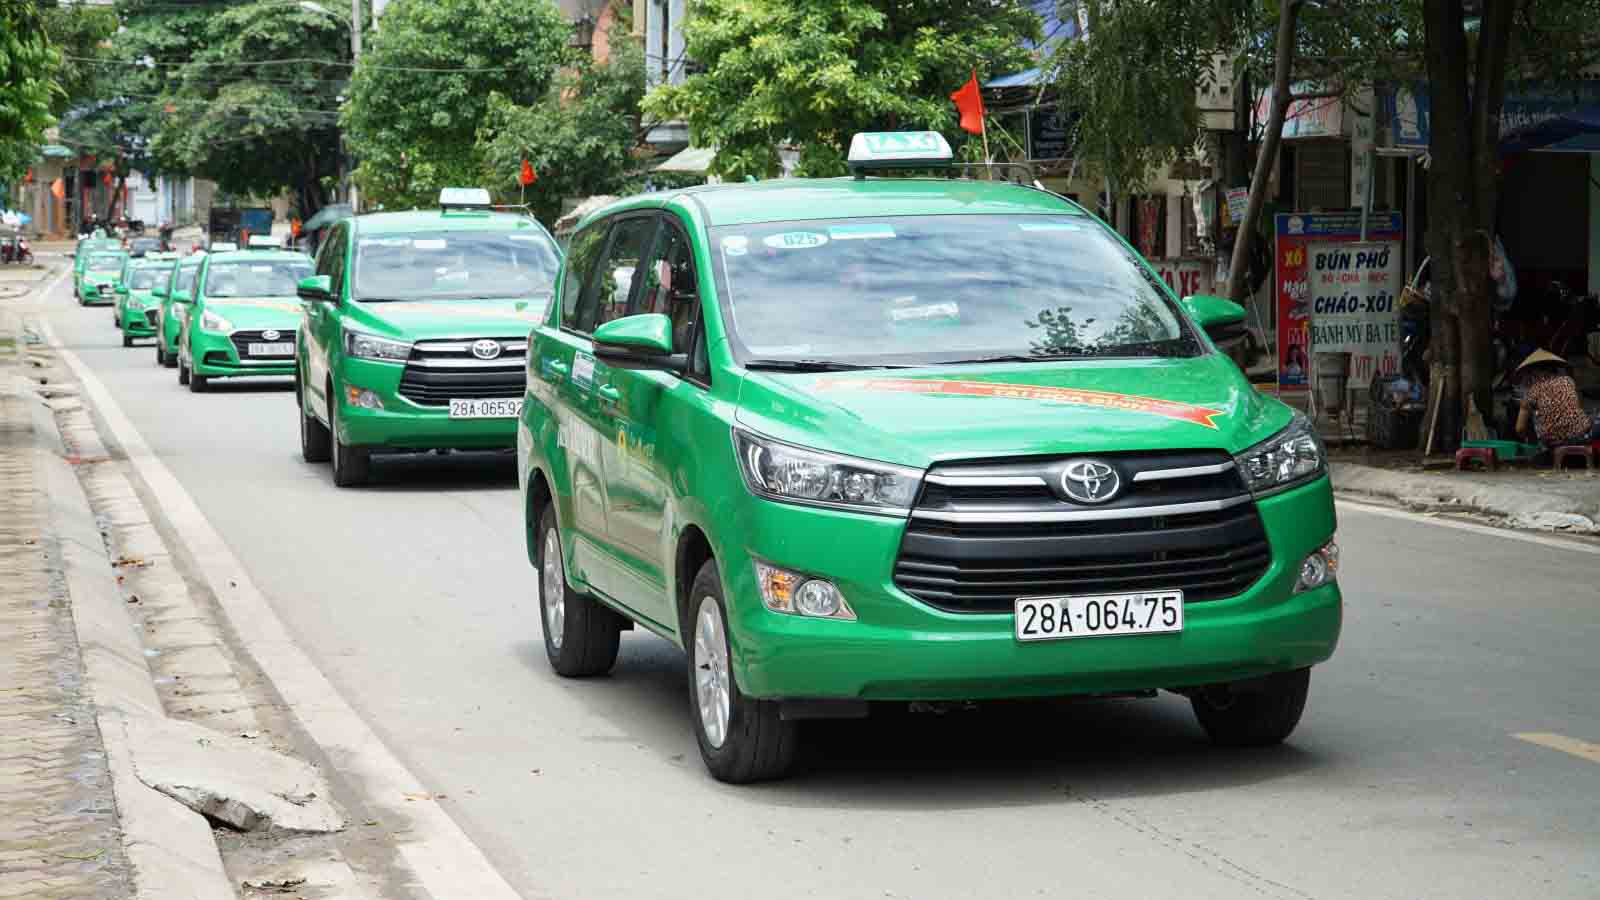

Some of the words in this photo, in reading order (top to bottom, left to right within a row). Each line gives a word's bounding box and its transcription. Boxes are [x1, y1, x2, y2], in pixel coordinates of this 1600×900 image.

[864, 133, 938, 152] TAXI
[1315, 249, 1351, 271] BÚN
[1355, 244, 1391, 269] PHỞ
[1313, 320, 1344, 345] BÁNH
[1022, 596, 1177, 635] 28A-064.75
